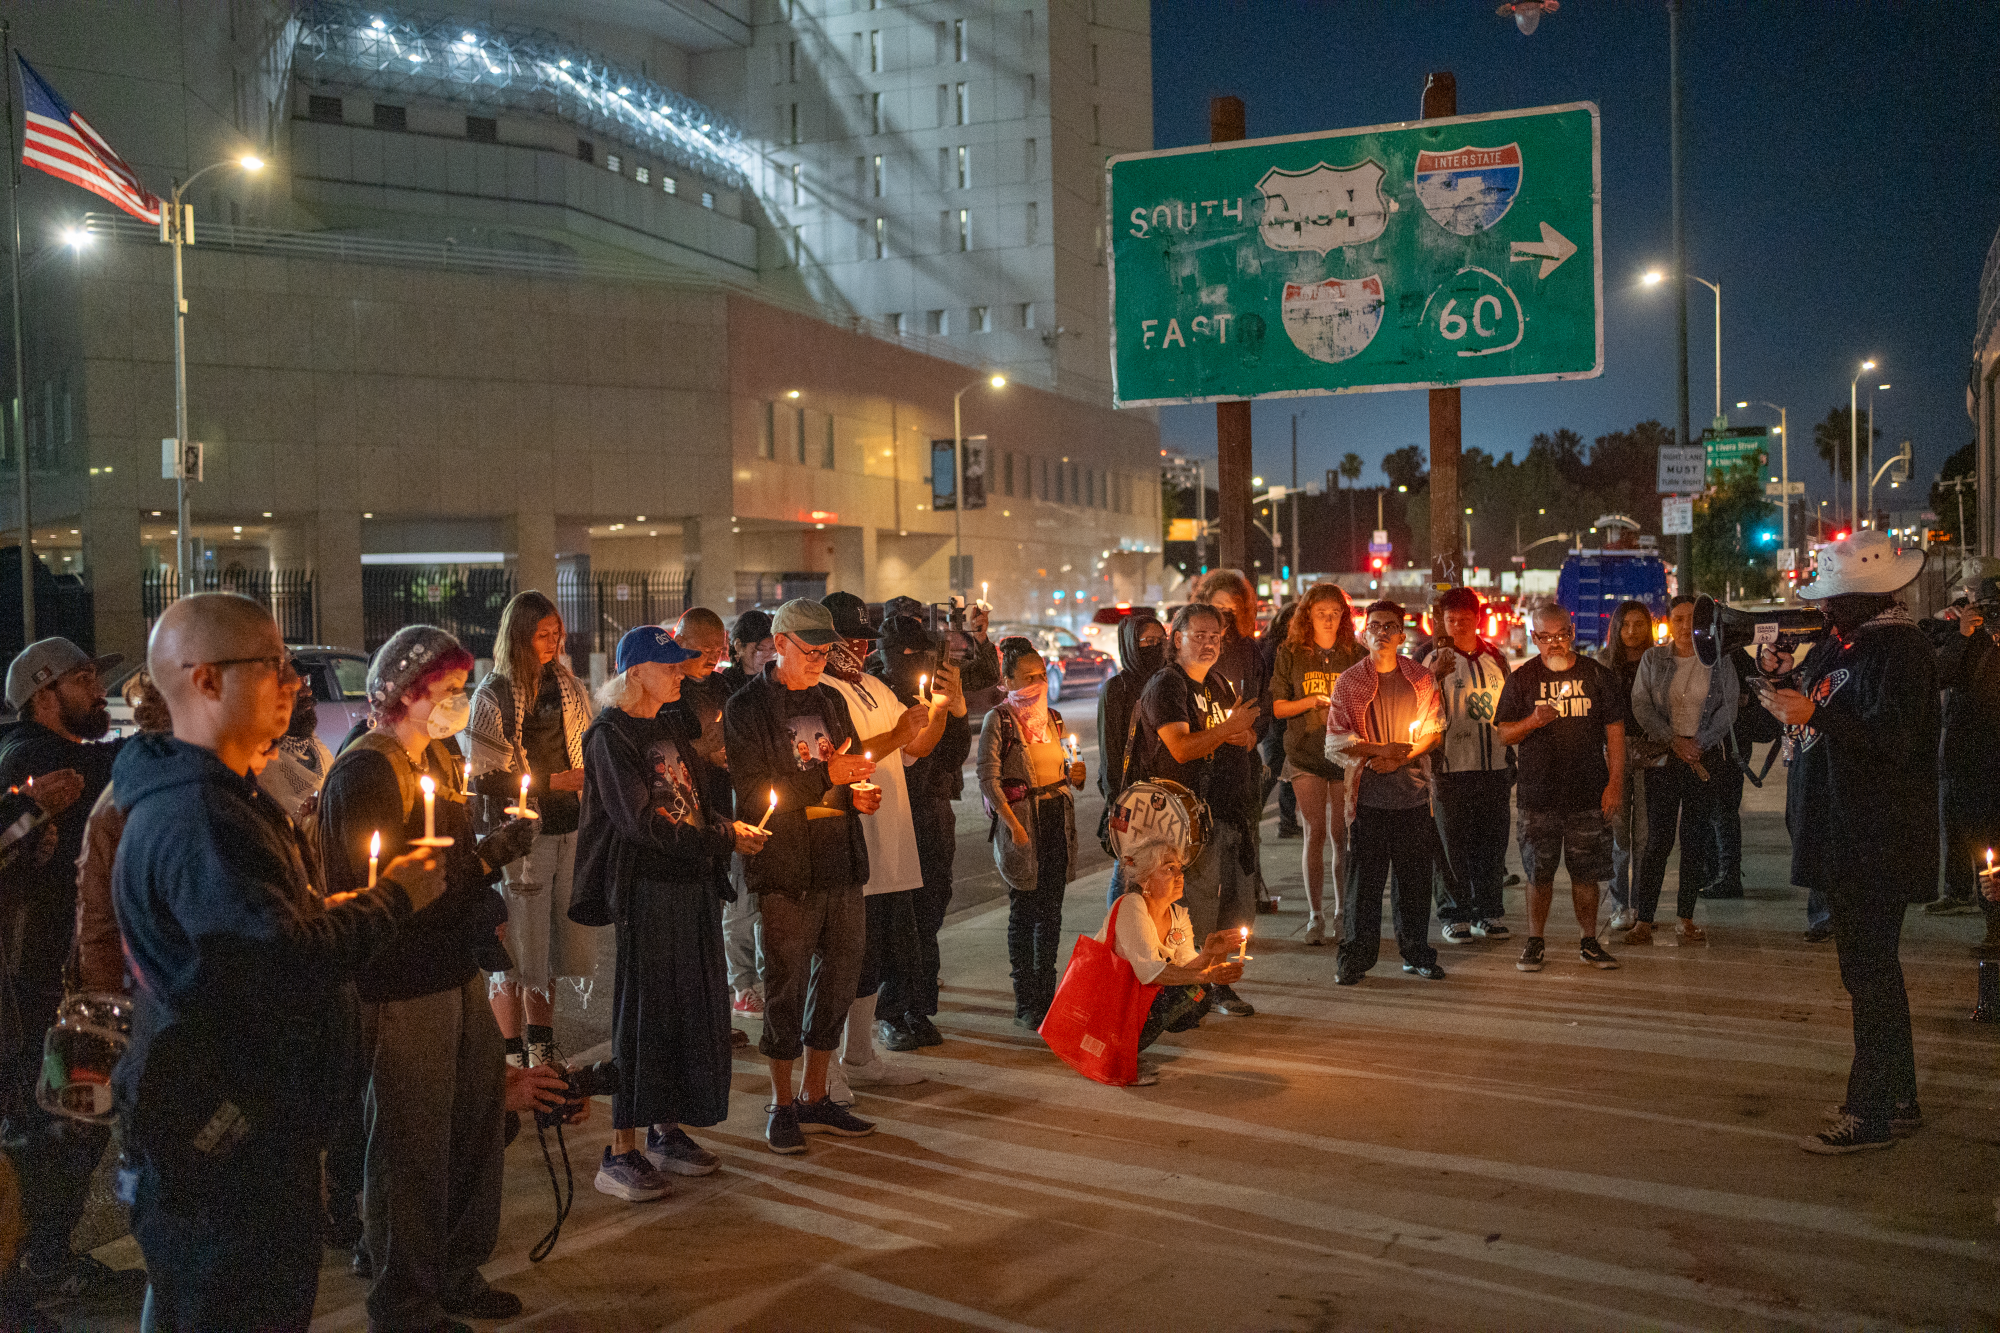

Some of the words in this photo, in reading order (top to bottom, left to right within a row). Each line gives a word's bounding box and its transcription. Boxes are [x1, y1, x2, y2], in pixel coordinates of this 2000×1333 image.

[1435, 152, 1502, 169] INTERSTATE
[1439, 294, 1503, 341] 60
[1666, 465, 1697, 474] MUST
[1540, 680, 1585, 698] FUCK
[1468, 692, 1494, 721] 88
[1132, 797, 1180, 839] FUCK
